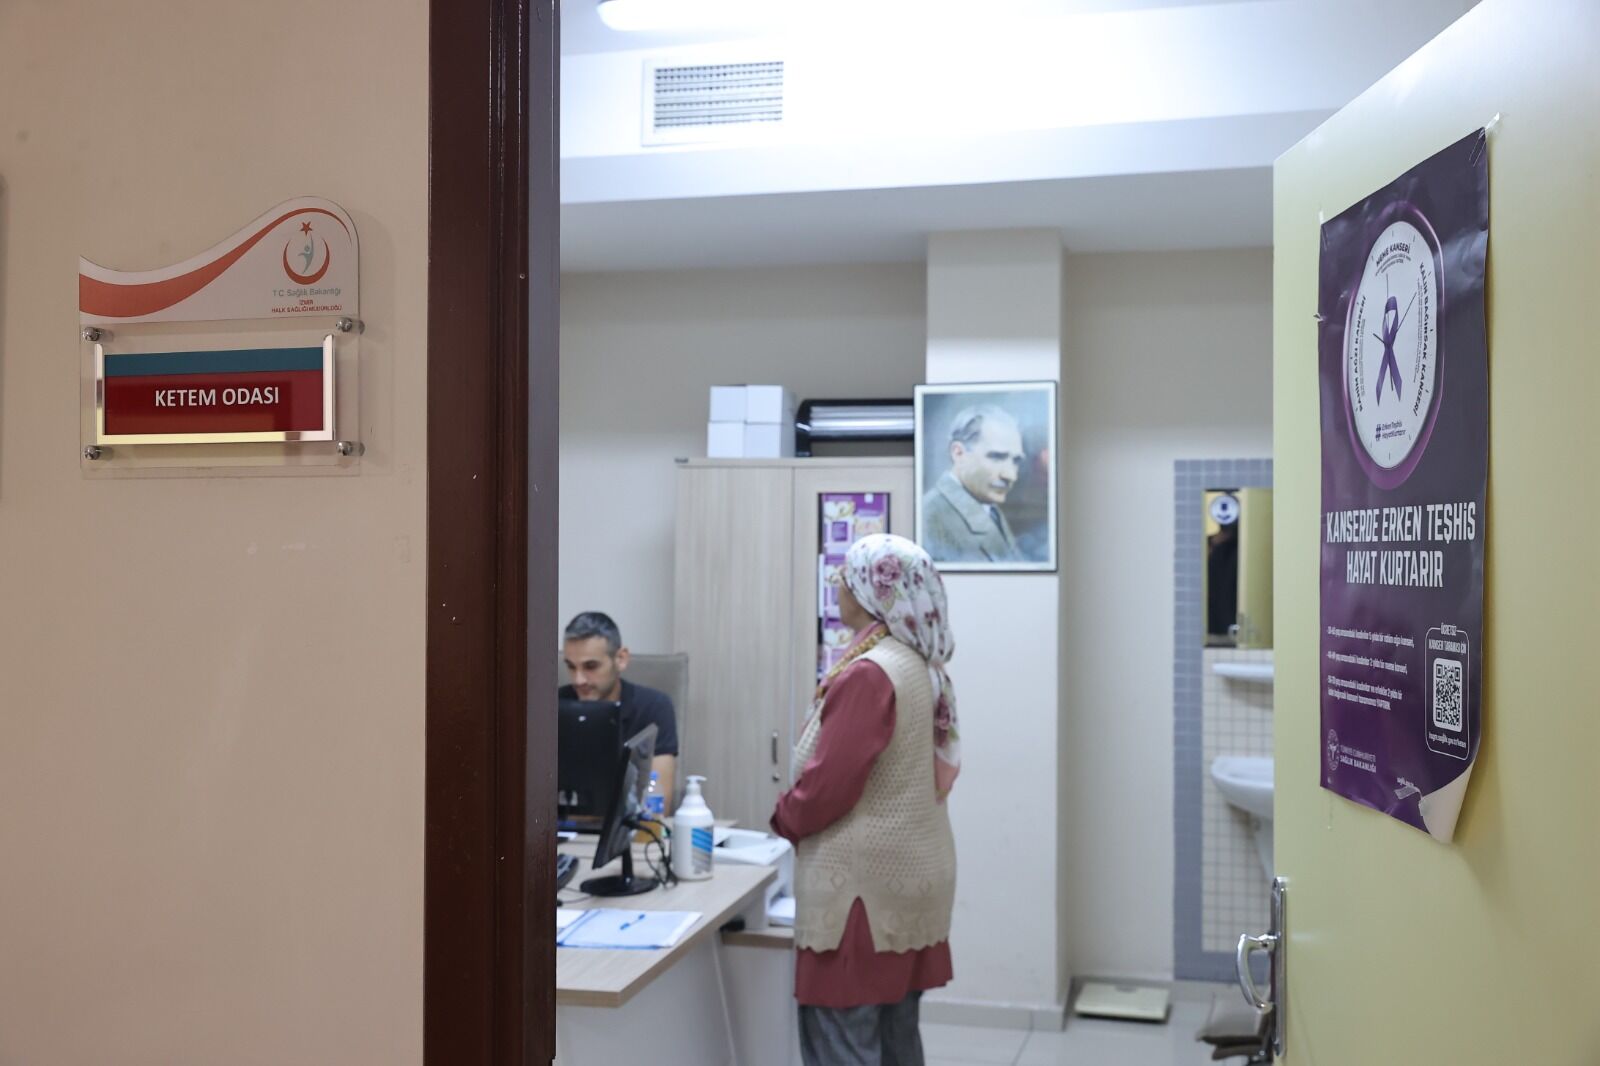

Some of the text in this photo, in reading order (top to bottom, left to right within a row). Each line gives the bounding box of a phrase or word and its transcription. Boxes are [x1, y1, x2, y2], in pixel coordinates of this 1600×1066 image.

[1376, 247, 1389, 267] MEME
[1390, 242, 1411, 254] KANSERİ
[1420, 261, 1428, 294] KALIN
[155, 386, 279, 407] KETEM ODASI
[1413, 363, 1426, 416] KANSERİ
[1326, 501, 1476, 544] KANSERDE ERKEN TEŞHİS
[1346, 550, 1444, 588] HAYAT KURTARIR
